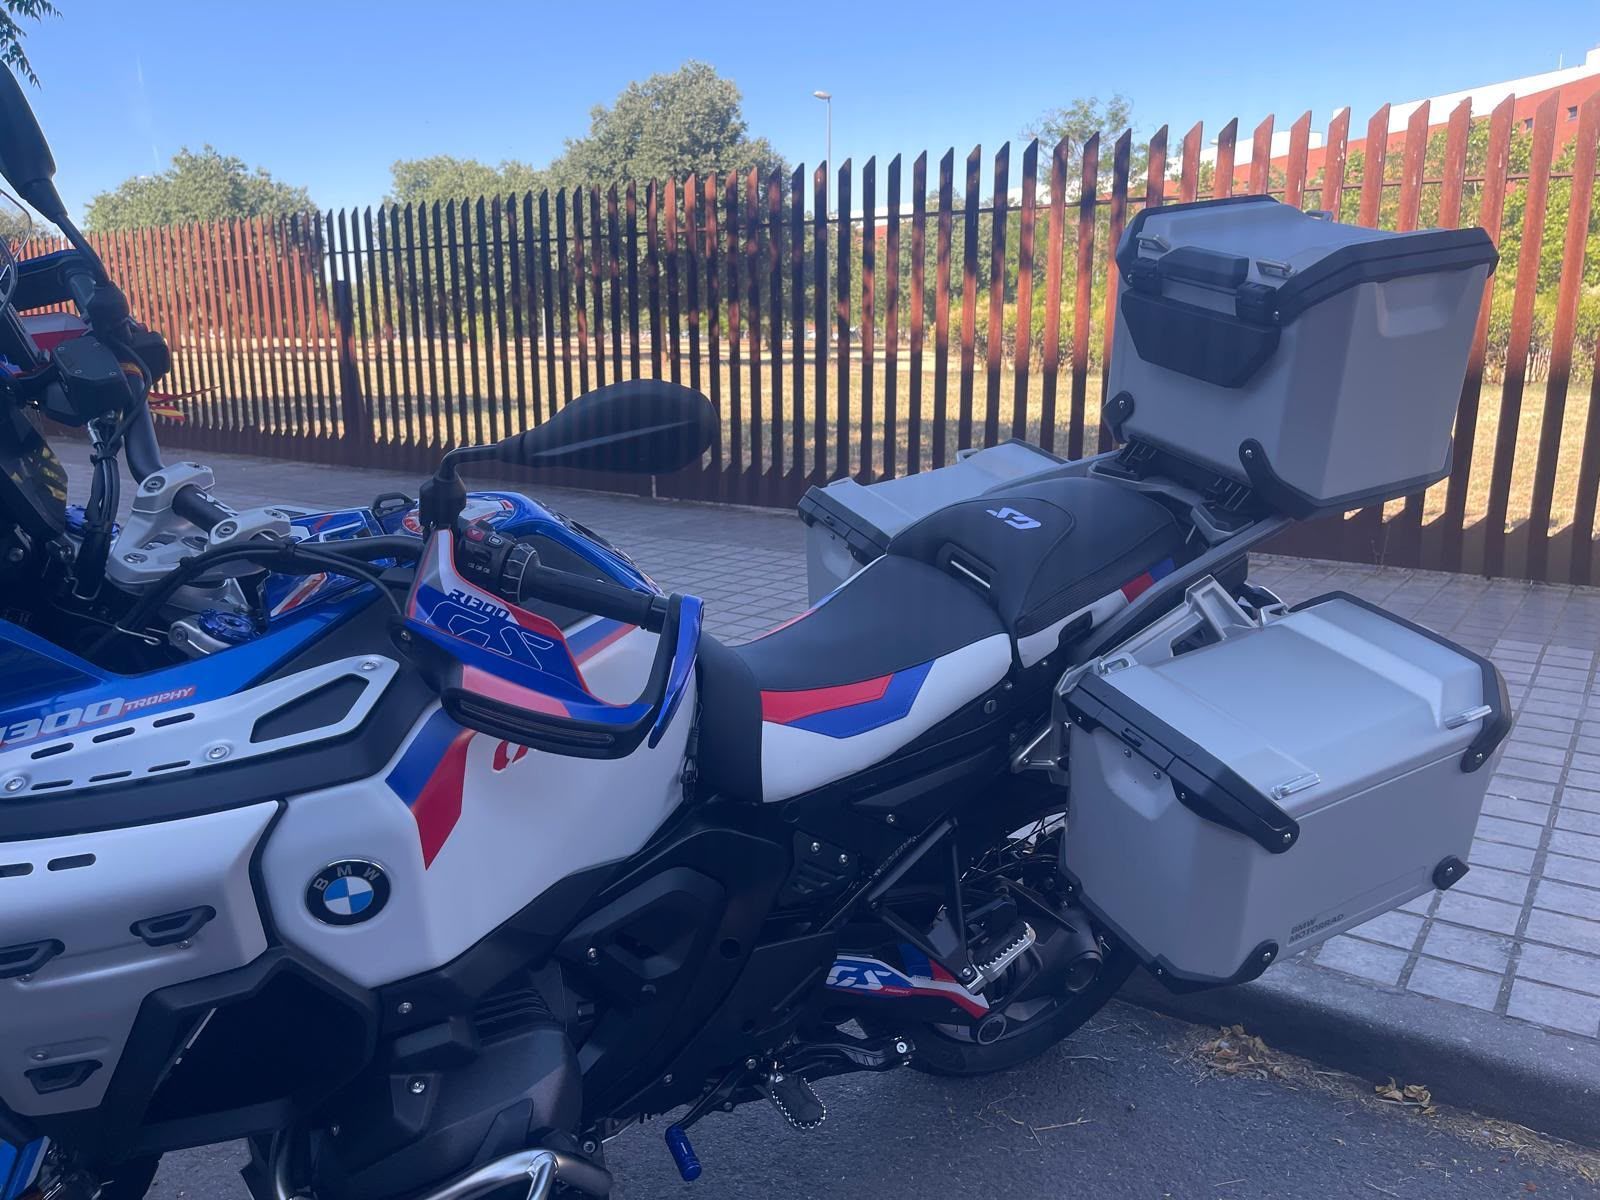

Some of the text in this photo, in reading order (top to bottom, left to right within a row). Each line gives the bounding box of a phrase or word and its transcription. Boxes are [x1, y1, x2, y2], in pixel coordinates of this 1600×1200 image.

[447, 588, 511, 622] R1300
[124, 687, 193, 713] TROPHY
[312, 864, 381, 892] BMW
[1287, 913, 1345, 946] MOTORRAD
[1290, 916, 1318, 935] BMW
[825, 965, 893, 992] GS
